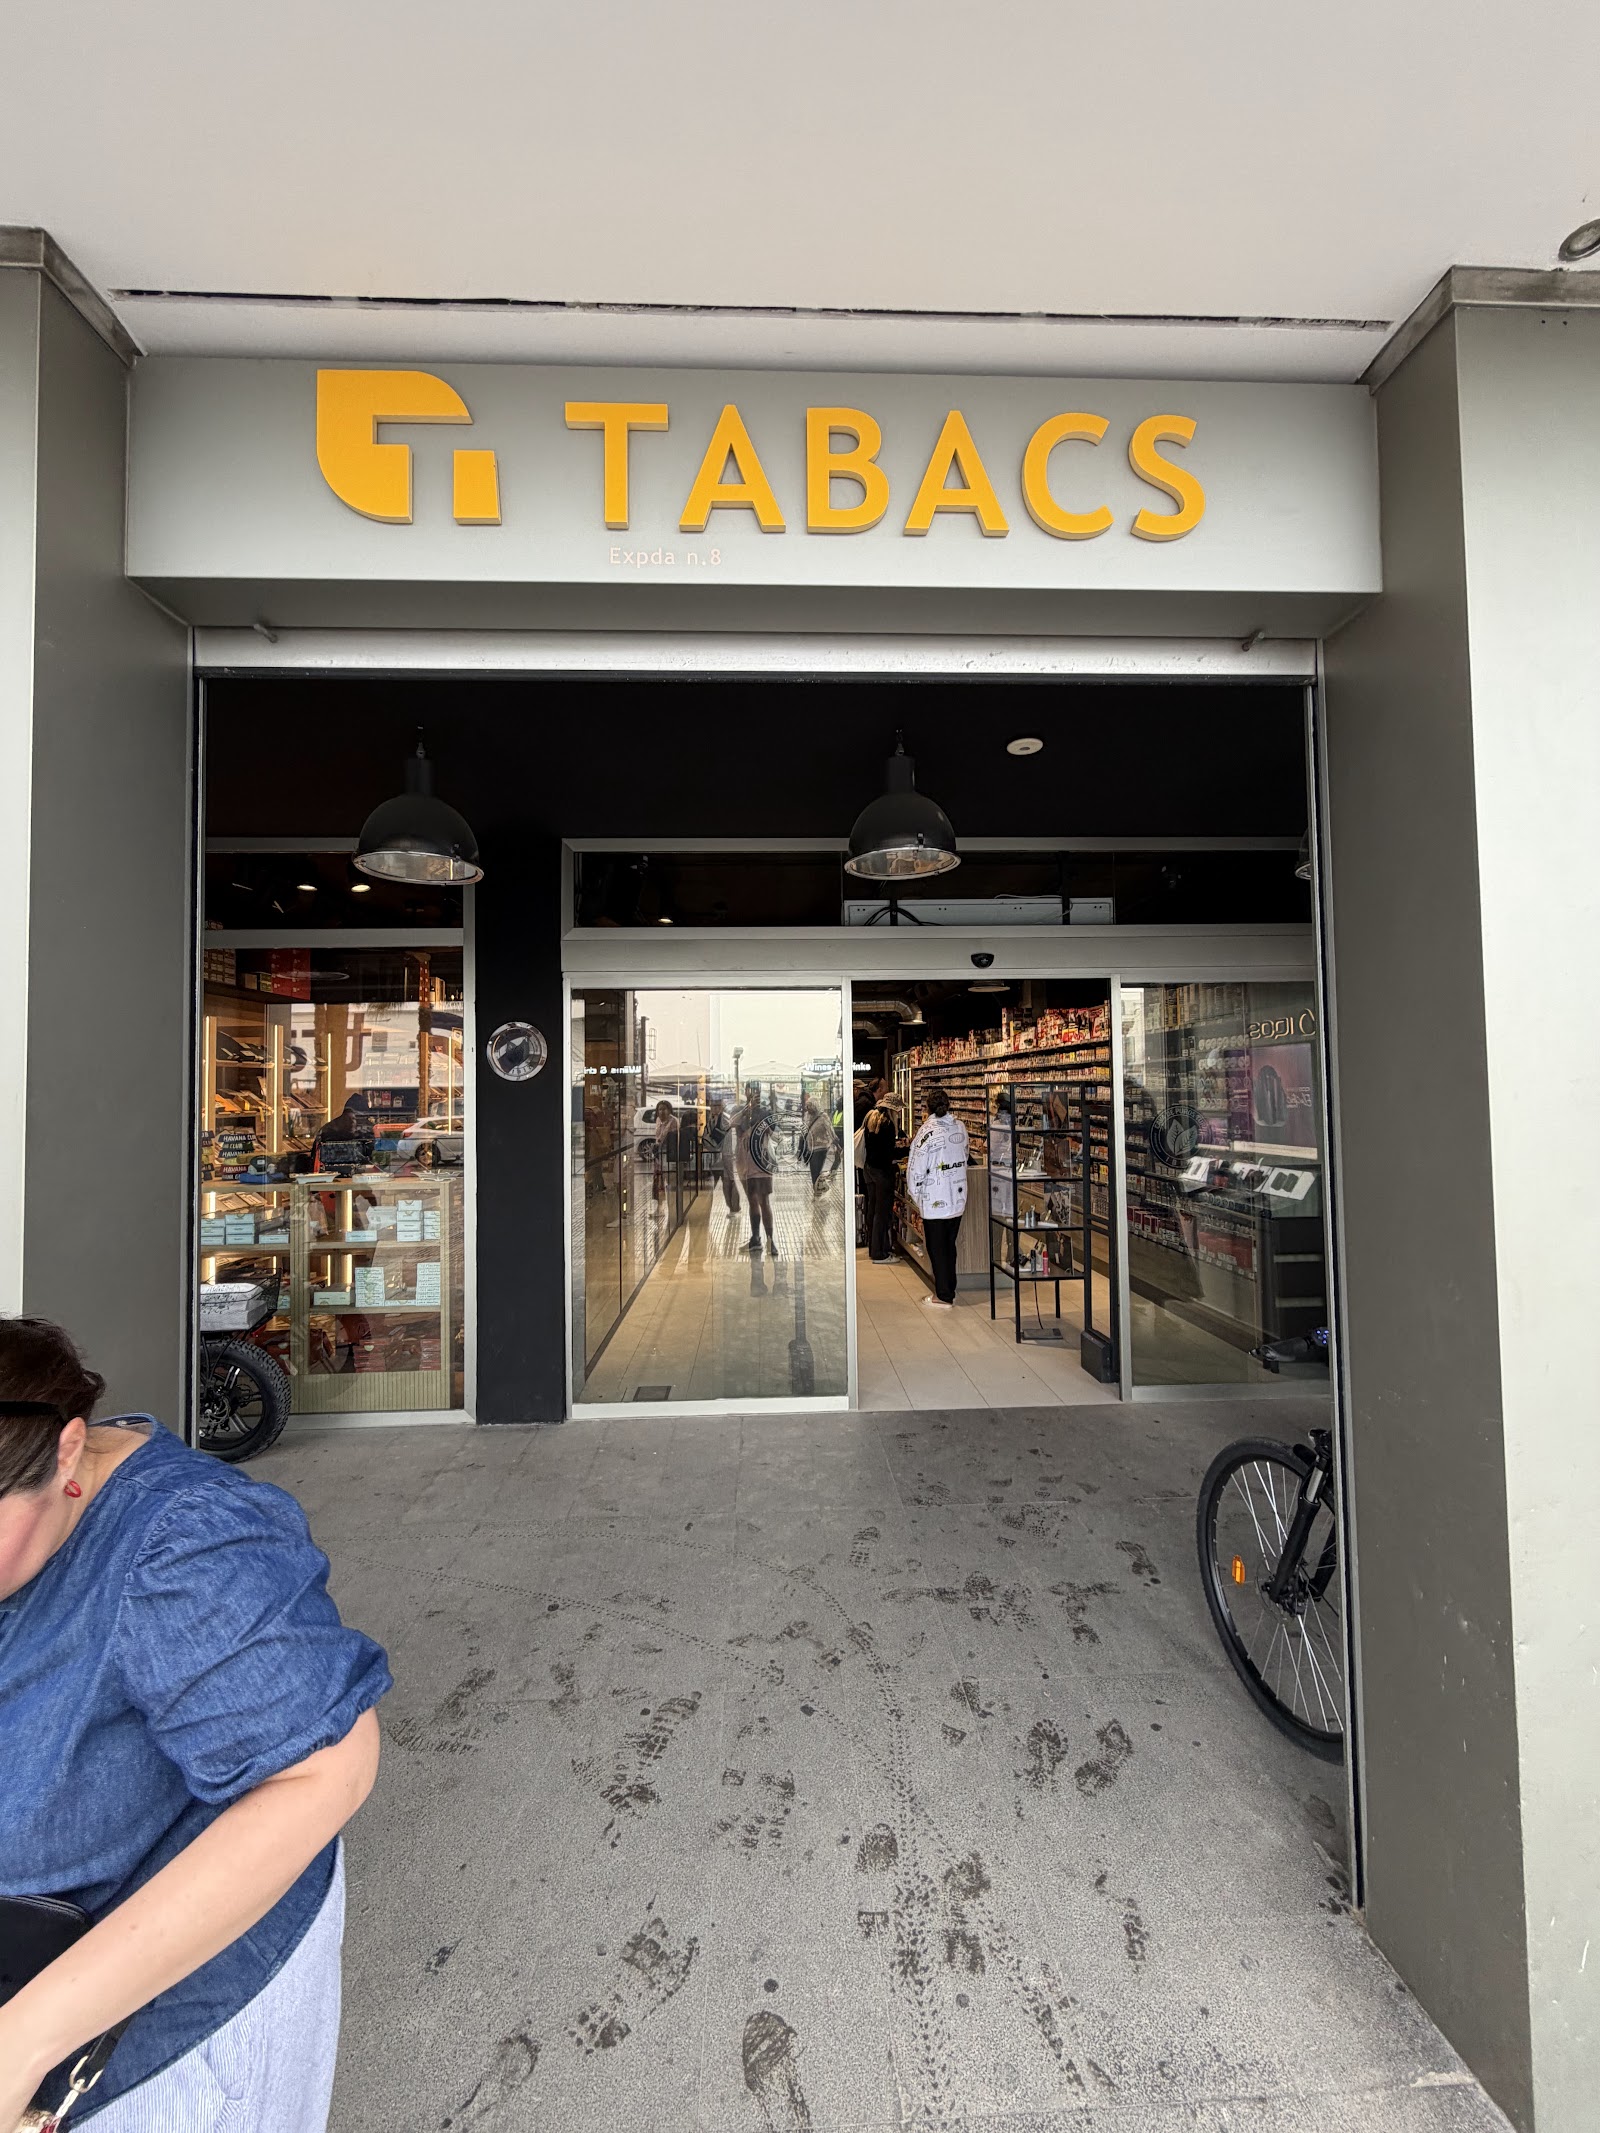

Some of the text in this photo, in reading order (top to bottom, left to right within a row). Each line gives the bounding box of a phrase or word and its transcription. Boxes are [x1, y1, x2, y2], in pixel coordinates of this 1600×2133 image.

[564, 402, 1207, 543] TABACS
[609, 547, 722, 569] Expda n.8
[805, 1062, 832, 1071] Wines
[852, 1061, 872, 1071] inks
[755, 1120, 769, 1136] CAVA
[767, 1115, 778, 1124] DE
[941, 1160, 966, 1171] BLAST
